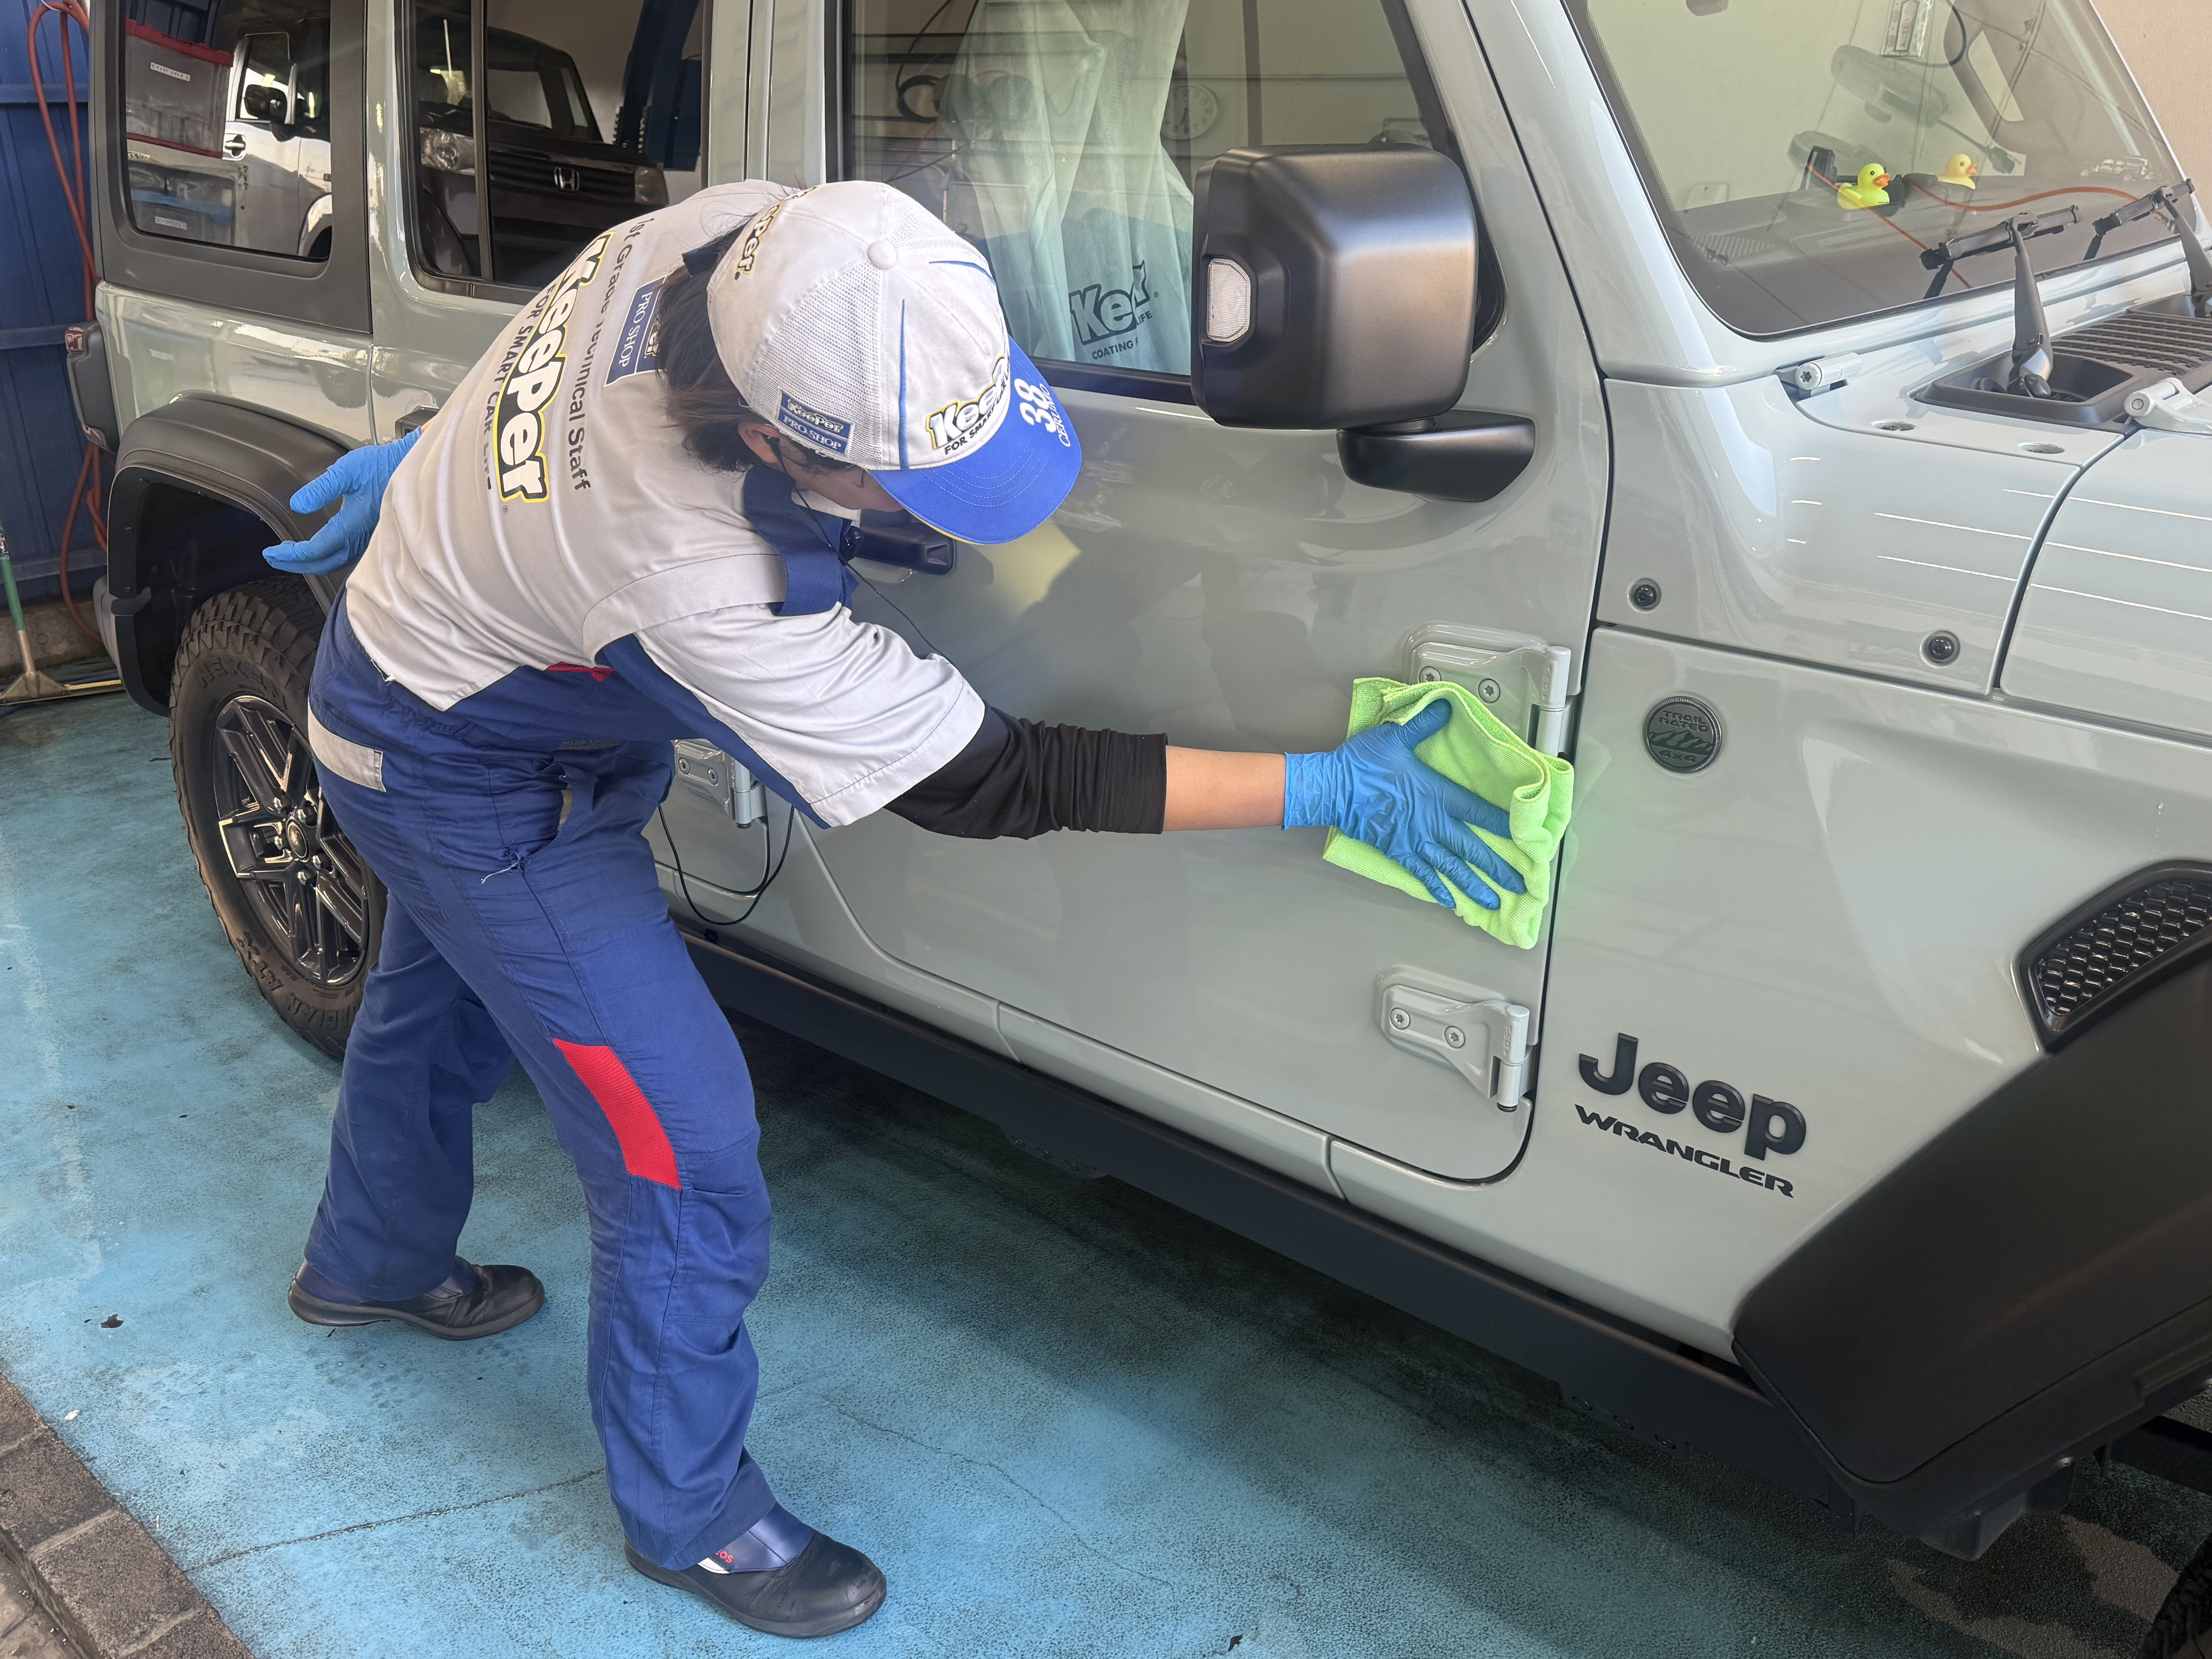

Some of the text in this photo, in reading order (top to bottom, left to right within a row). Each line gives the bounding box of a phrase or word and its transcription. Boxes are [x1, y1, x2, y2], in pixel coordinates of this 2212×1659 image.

[624, 218, 654, 241] 1st
[527, 283, 556, 319] FOR
[633, 291, 653, 324] PRO
[494, 325, 534, 383] SMART
[618, 325, 641, 367] SHOP
[1092, 340, 1134, 359] COATING
[927, 354, 1006, 449] KeeP
[1014, 378, 1057, 433] 38
[944, 438, 968, 455] FOR
[969, 404, 996, 439] SMART
[568, 427, 591, 490] Staff
[1658, 717, 1709, 732] RATED
[1662, 709, 1706, 725] TRAIL
[1578, 1032, 1807, 1161] Jeep
[1574, 1104, 1795, 1199] WRANGLER
[715, 1549, 734, 1564] OS
